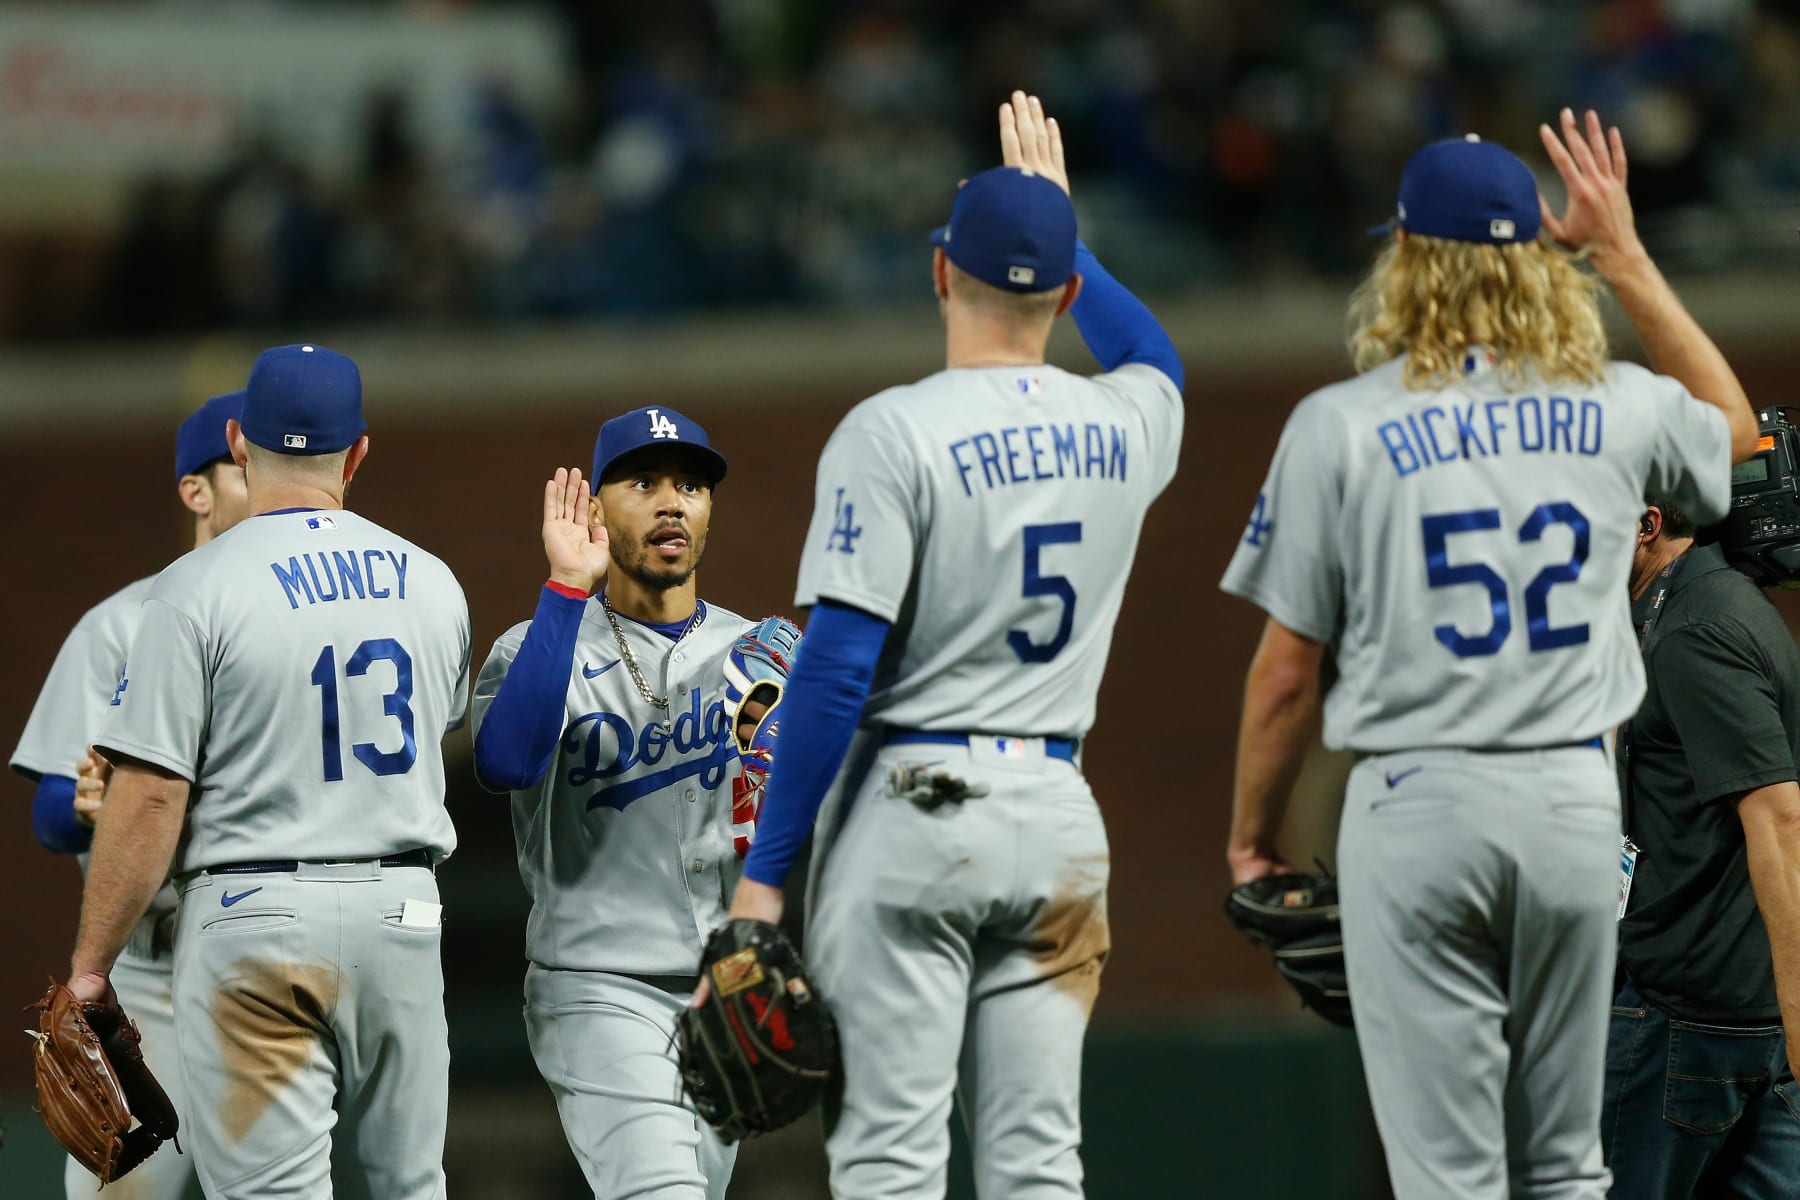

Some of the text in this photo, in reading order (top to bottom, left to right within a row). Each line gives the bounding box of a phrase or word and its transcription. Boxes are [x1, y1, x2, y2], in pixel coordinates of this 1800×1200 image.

[646, 408, 679, 440] LA
[949, 422, 1127, 497] FREEMAN
[1377, 396, 1603, 477] BICKFORD
[827, 487, 863, 556] LA
[271, 549, 408, 609] MUNCY
[1008, 521, 1083, 664] 5
[1422, 501, 1591, 658] 52
[311, 638, 417, 782] 13
